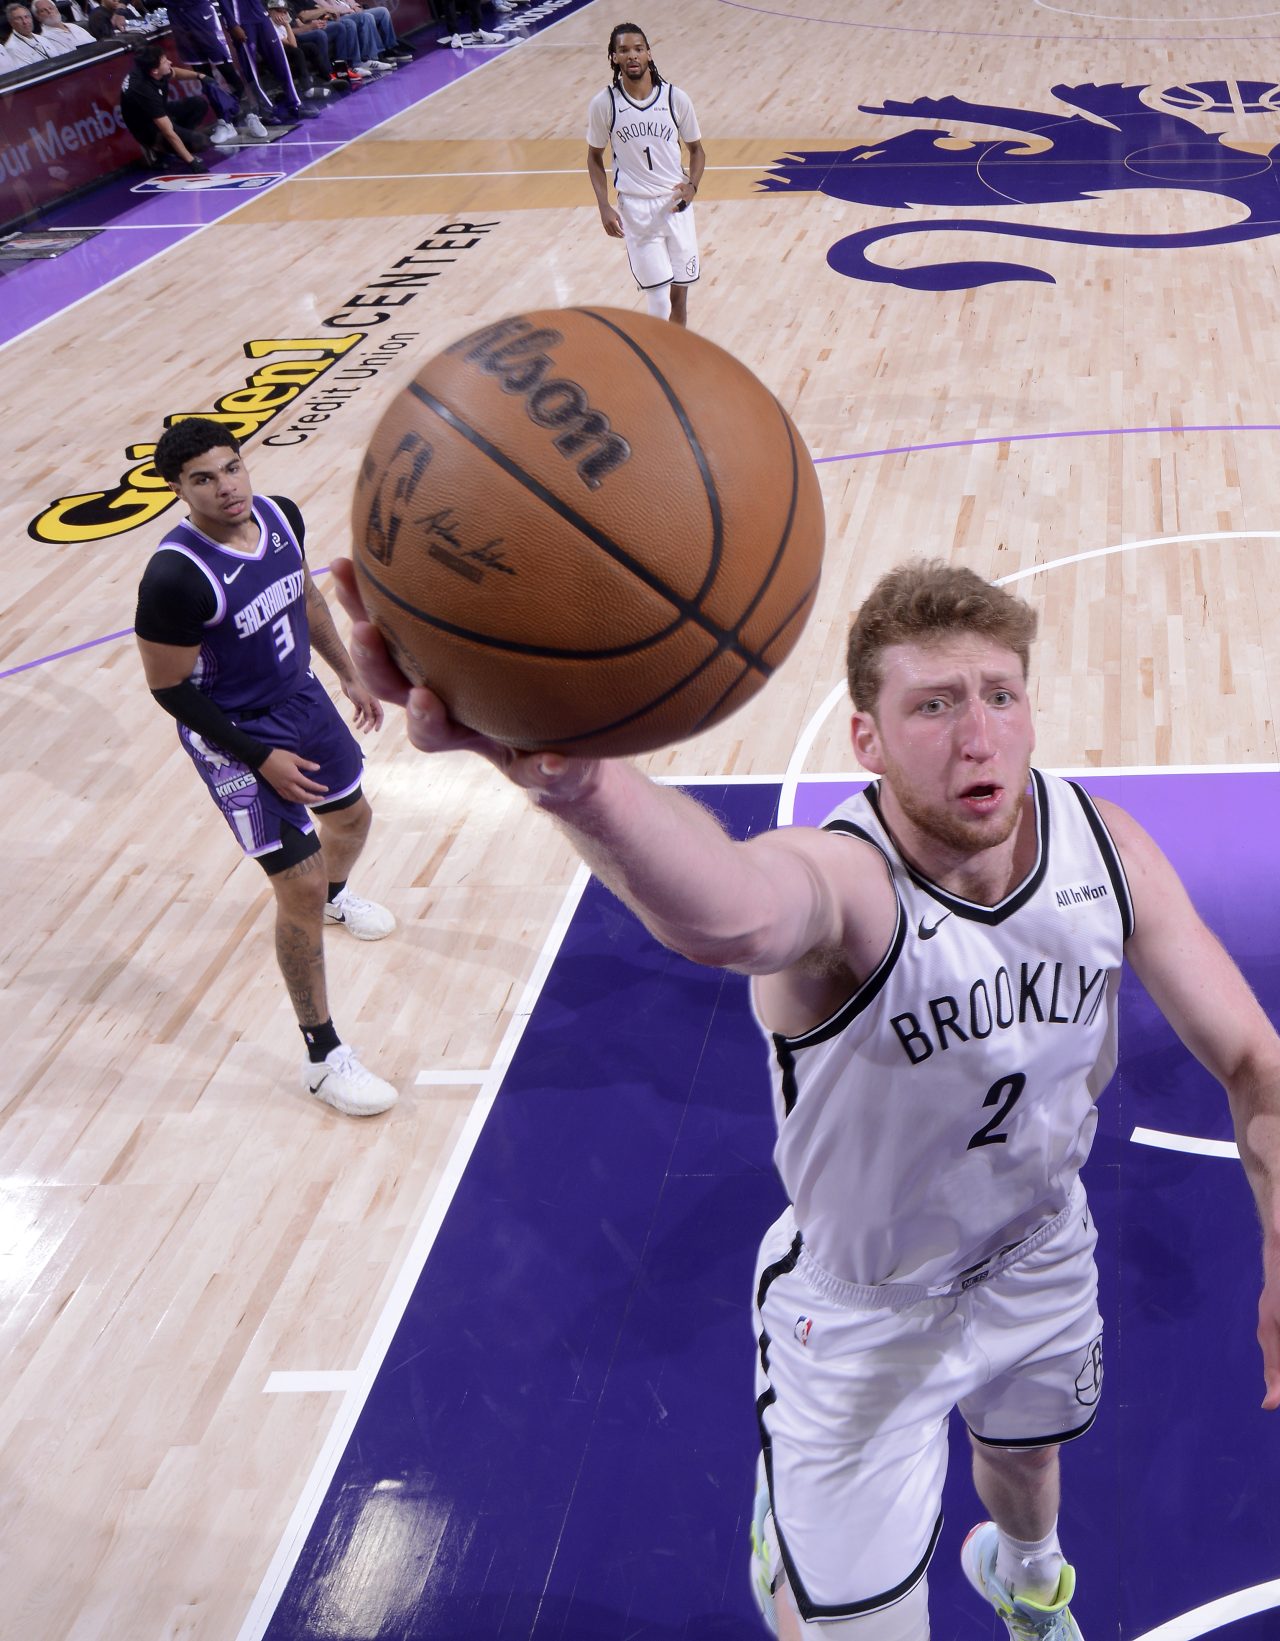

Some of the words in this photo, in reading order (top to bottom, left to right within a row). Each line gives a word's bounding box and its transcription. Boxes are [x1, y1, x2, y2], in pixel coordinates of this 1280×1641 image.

[28, 101, 128, 164] Membe
[616, 121, 673, 144] BROOKLYN
[643, 146, 654, 171] 1
[27, 332, 367, 544] Goden1
[322, 220, 501, 328] CENTER
[262, 386, 361, 447] Credit
[333, 332, 420, 380] Union
[272, 612, 296, 663] 3
[215, 772, 257, 798] KINGS
[1055, 889, 1072, 908] All
[1069, 888, 1084, 903] In
[1079, 884, 1108, 901] Won
[967, 1072, 1027, 1152] 2
